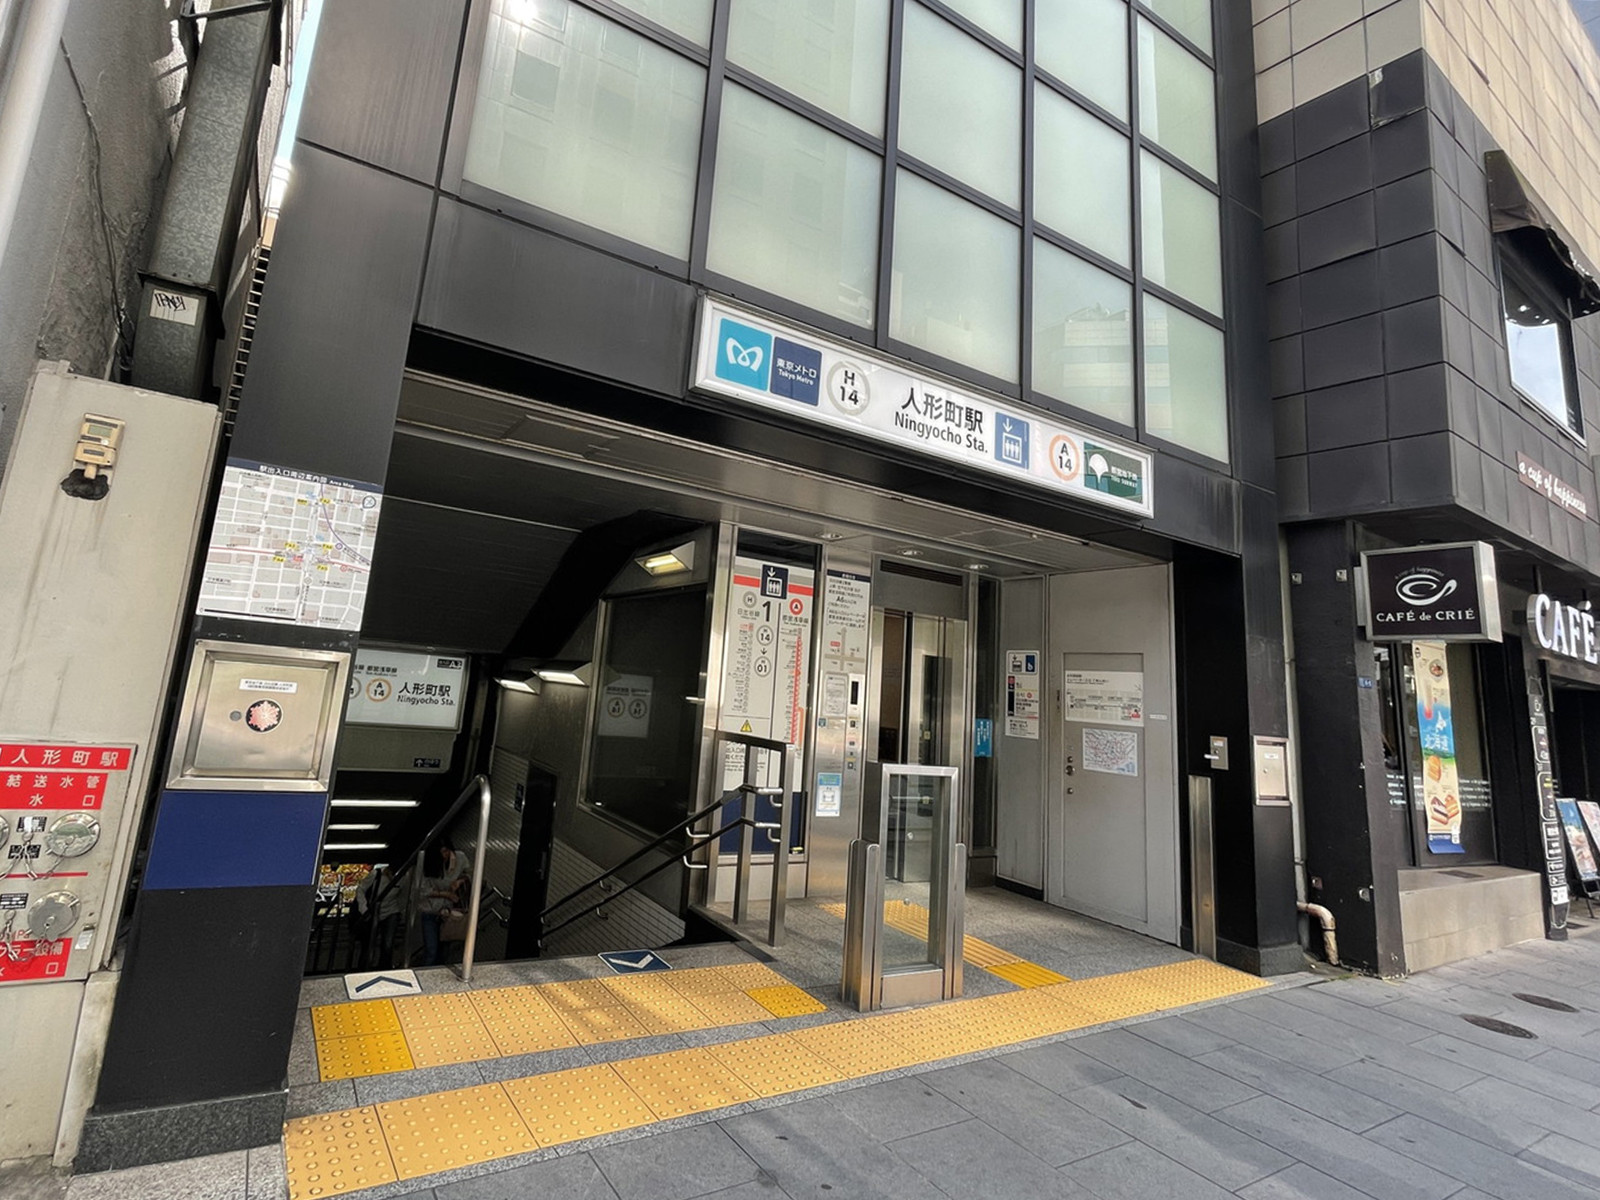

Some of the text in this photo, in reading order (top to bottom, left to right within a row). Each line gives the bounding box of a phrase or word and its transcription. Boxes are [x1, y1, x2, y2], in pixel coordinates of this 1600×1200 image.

[776, 358, 817, 378] 東京メトロ
[778, 369, 814, 386] Tokyo Metro
[844, 370, 855, 387] H
[840, 385, 859, 405] 14
[901, 387, 983, 434] 人形町駅
[894, 411, 988, 453] Ningyocho Sta.
[1060, 443, 1069, 456] A
[1058, 455, 1072, 471] 14
[1527, 466, 1542, 488] cup
[762, 600, 771, 622] 1
[1376, 608, 1475, 622] CAFÉ de CRIÉ
[1536, 594, 1598, 665] CAFÉ
[757, 664, 767, 672] 01
[374, 689, 385, 697] 14
[399, 682, 451, 697] 人形町駅
[397, 695, 456, 706] Ningyocho Sta.
[0, 748, 119, 767] 人形町駅
